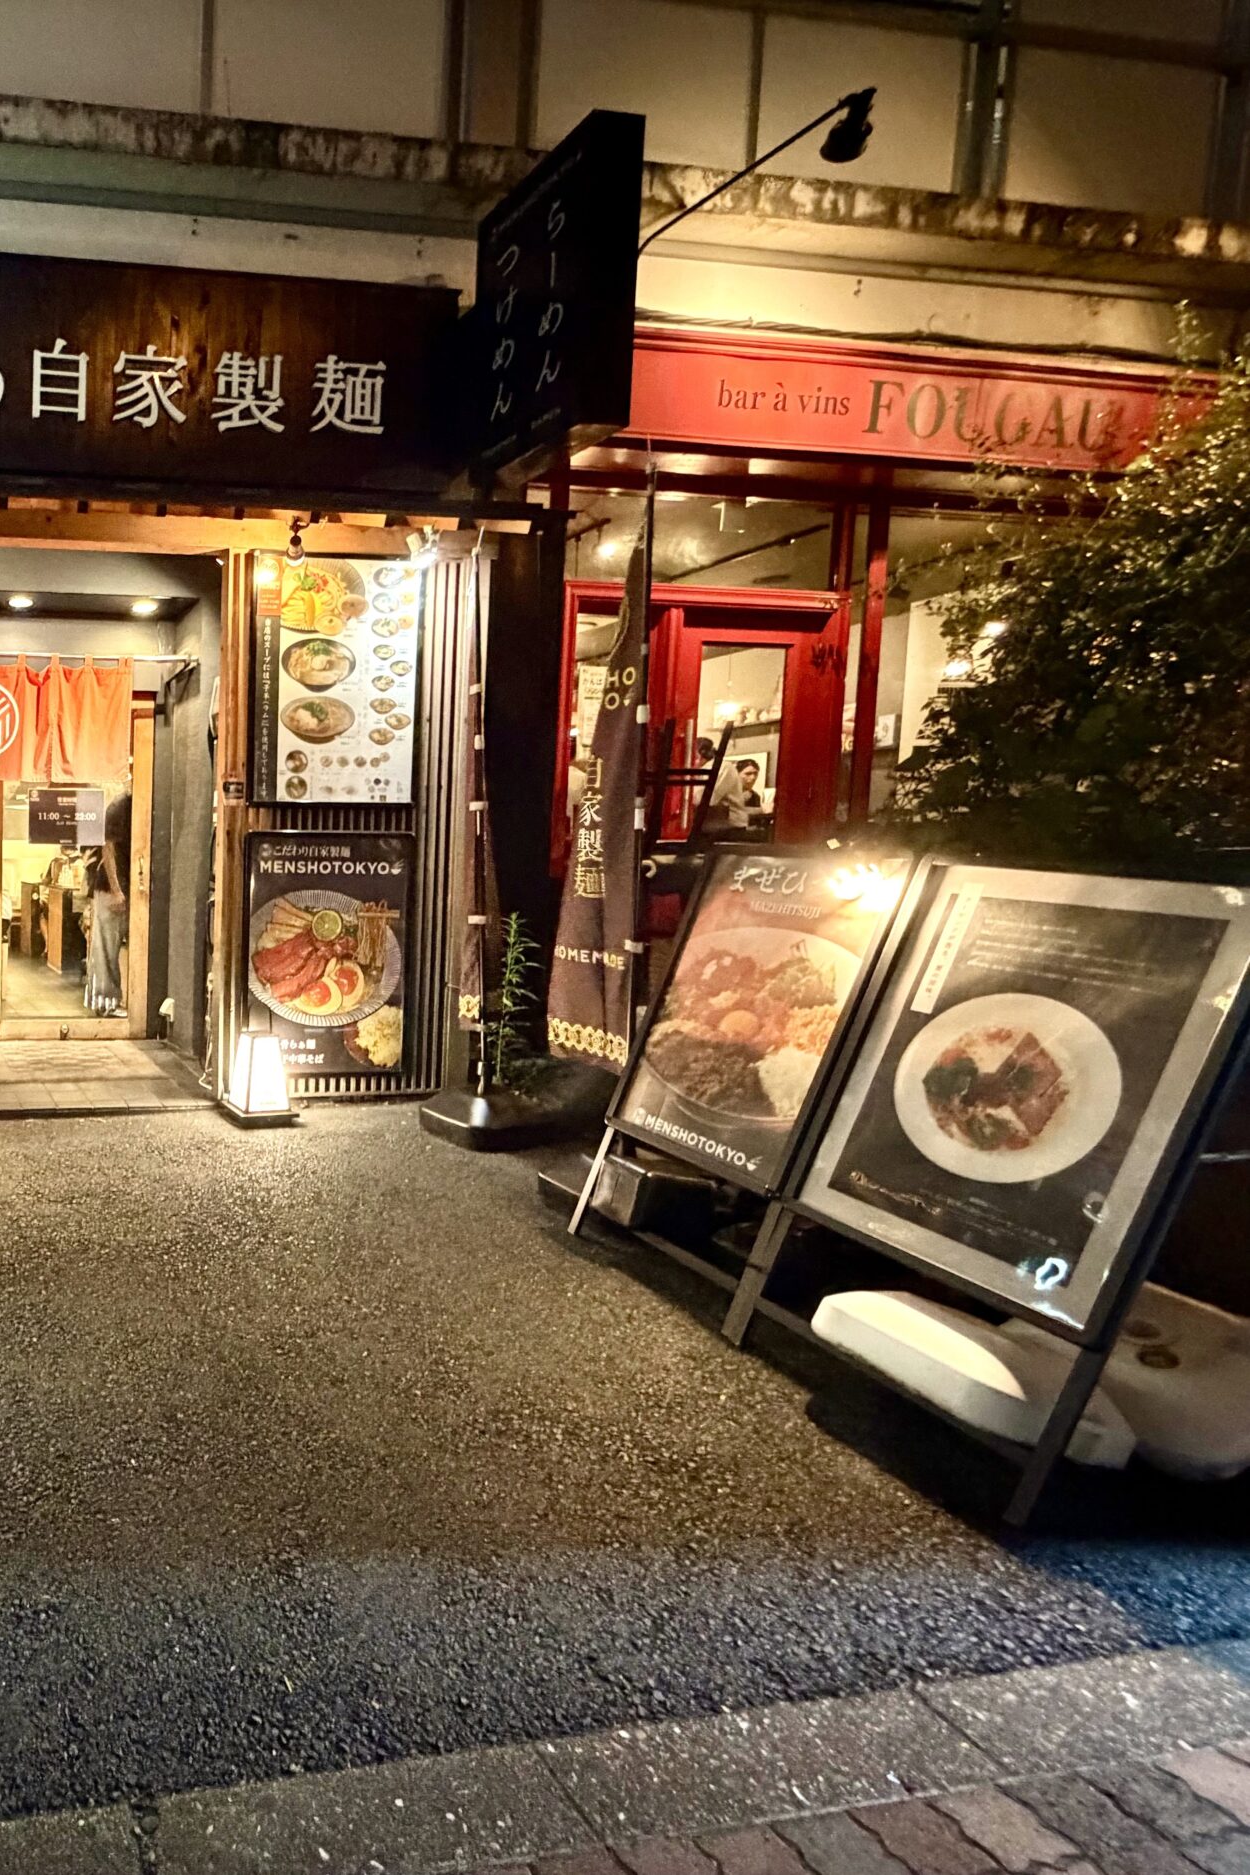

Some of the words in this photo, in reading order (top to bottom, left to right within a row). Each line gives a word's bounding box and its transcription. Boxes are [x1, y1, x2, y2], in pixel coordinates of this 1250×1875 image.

[536, 198, 566, 390] らーめん
[490, 244, 520, 422] つけめん
[718, 379, 767, 410] bar
[797, 386, 850, 416] vins
[259, 860, 390, 876] MENSHOTOKYO
[645, 1113, 747, 1166] MENSHOTOKYO
